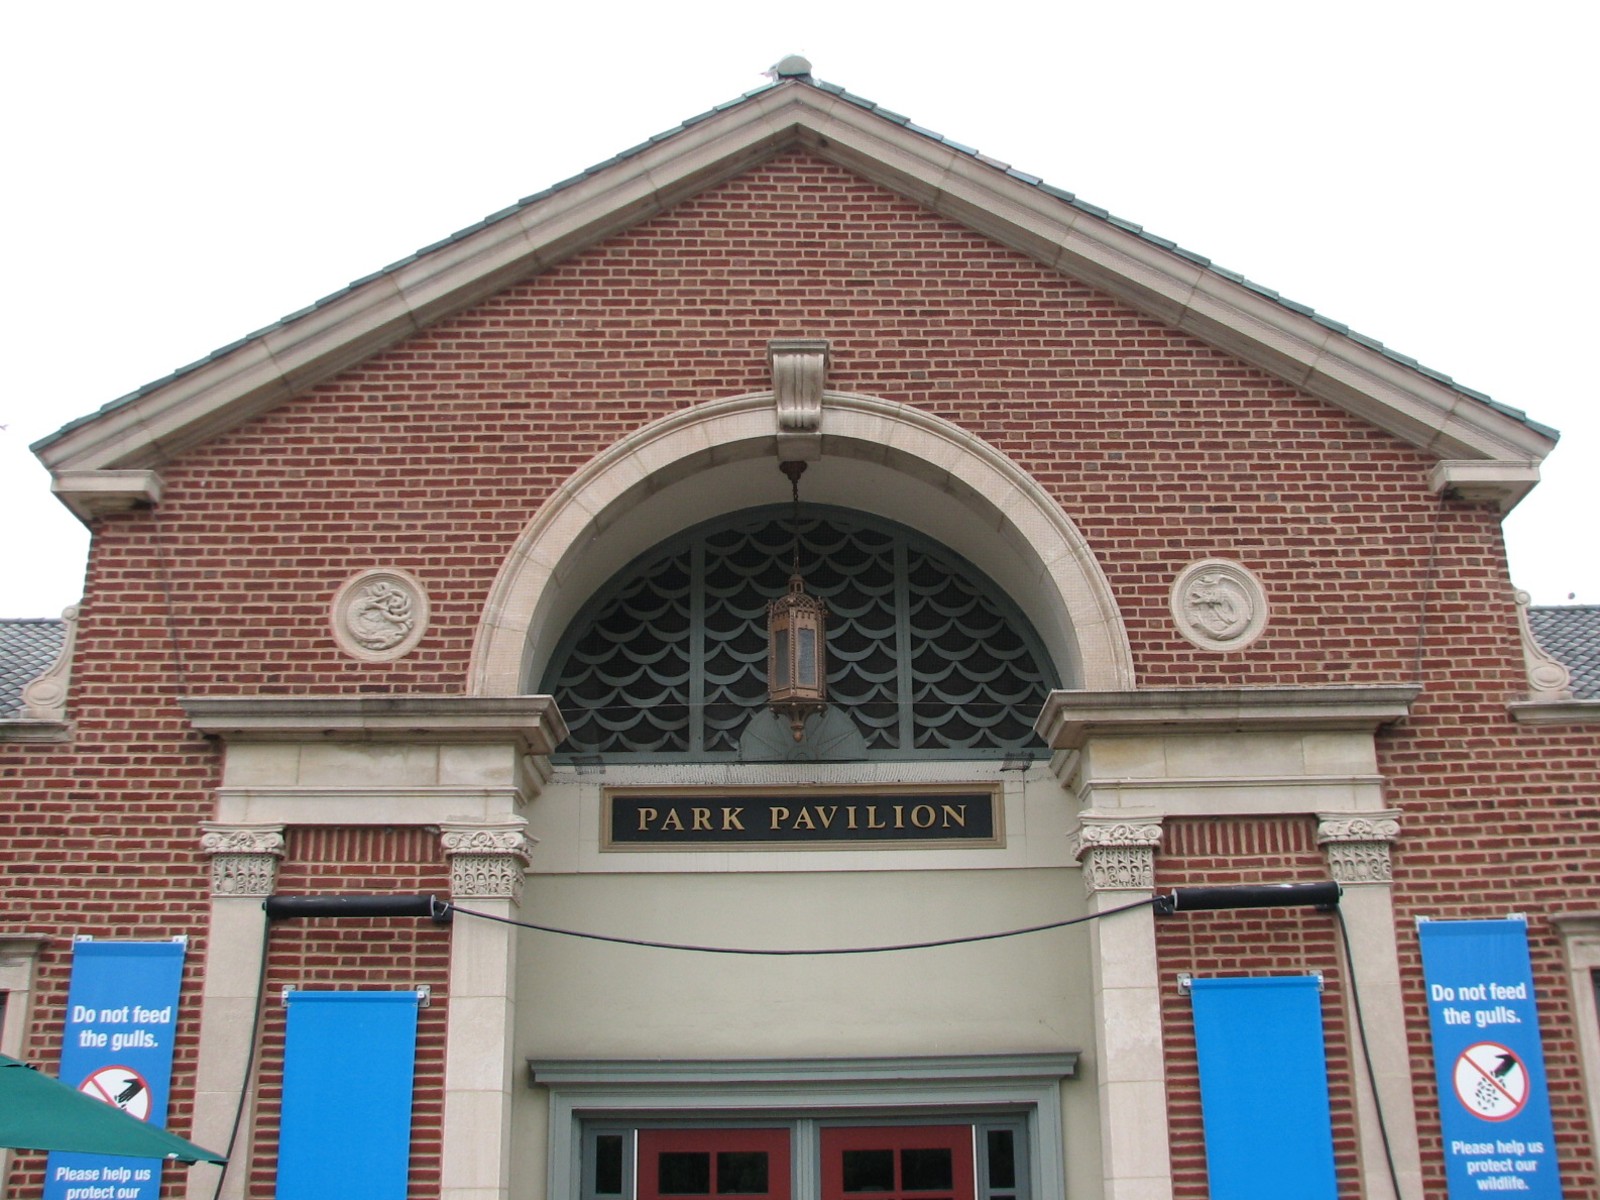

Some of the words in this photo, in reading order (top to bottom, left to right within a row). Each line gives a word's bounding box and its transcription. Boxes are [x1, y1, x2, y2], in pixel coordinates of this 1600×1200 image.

[637, 806, 745, 831] PARK
[769, 804, 967, 830] PAVILION
[1432, 984, 1454, 1001] Do
[1459, 985, 1486, 1001] not
[1490, 982, 1526, 1000] feed
[73, 1005, 95, 1023] Do
[101, 1007, 128, 1024] not
[133, 1006, 171, 1024] feed
[1443, 1007, 1470, 1025] the
[1475, 1006, 1521, 1028] gulls.
[80, 1030, 107, 1048] the
[111, 1030, 158, 1051] gulls.
[1452, 1141, 1494, 1155] Please
[1497, 1140, 1524, 1157] help
[1529, 1141, 1544, 1153] us
[56, 1166, 99, 1181] Please
[103, 1167, 131, 1184] help
[134, 1168, 151, 1181] us
[1467, 1160, 1513, 1175] protect
[1516, 1160, 1538, 1172] our
[67, 1185, 114, 1200] protect
[116, 1186, 140, 1199] our
[1477, 1176, 1529, 1191] wildlife.
